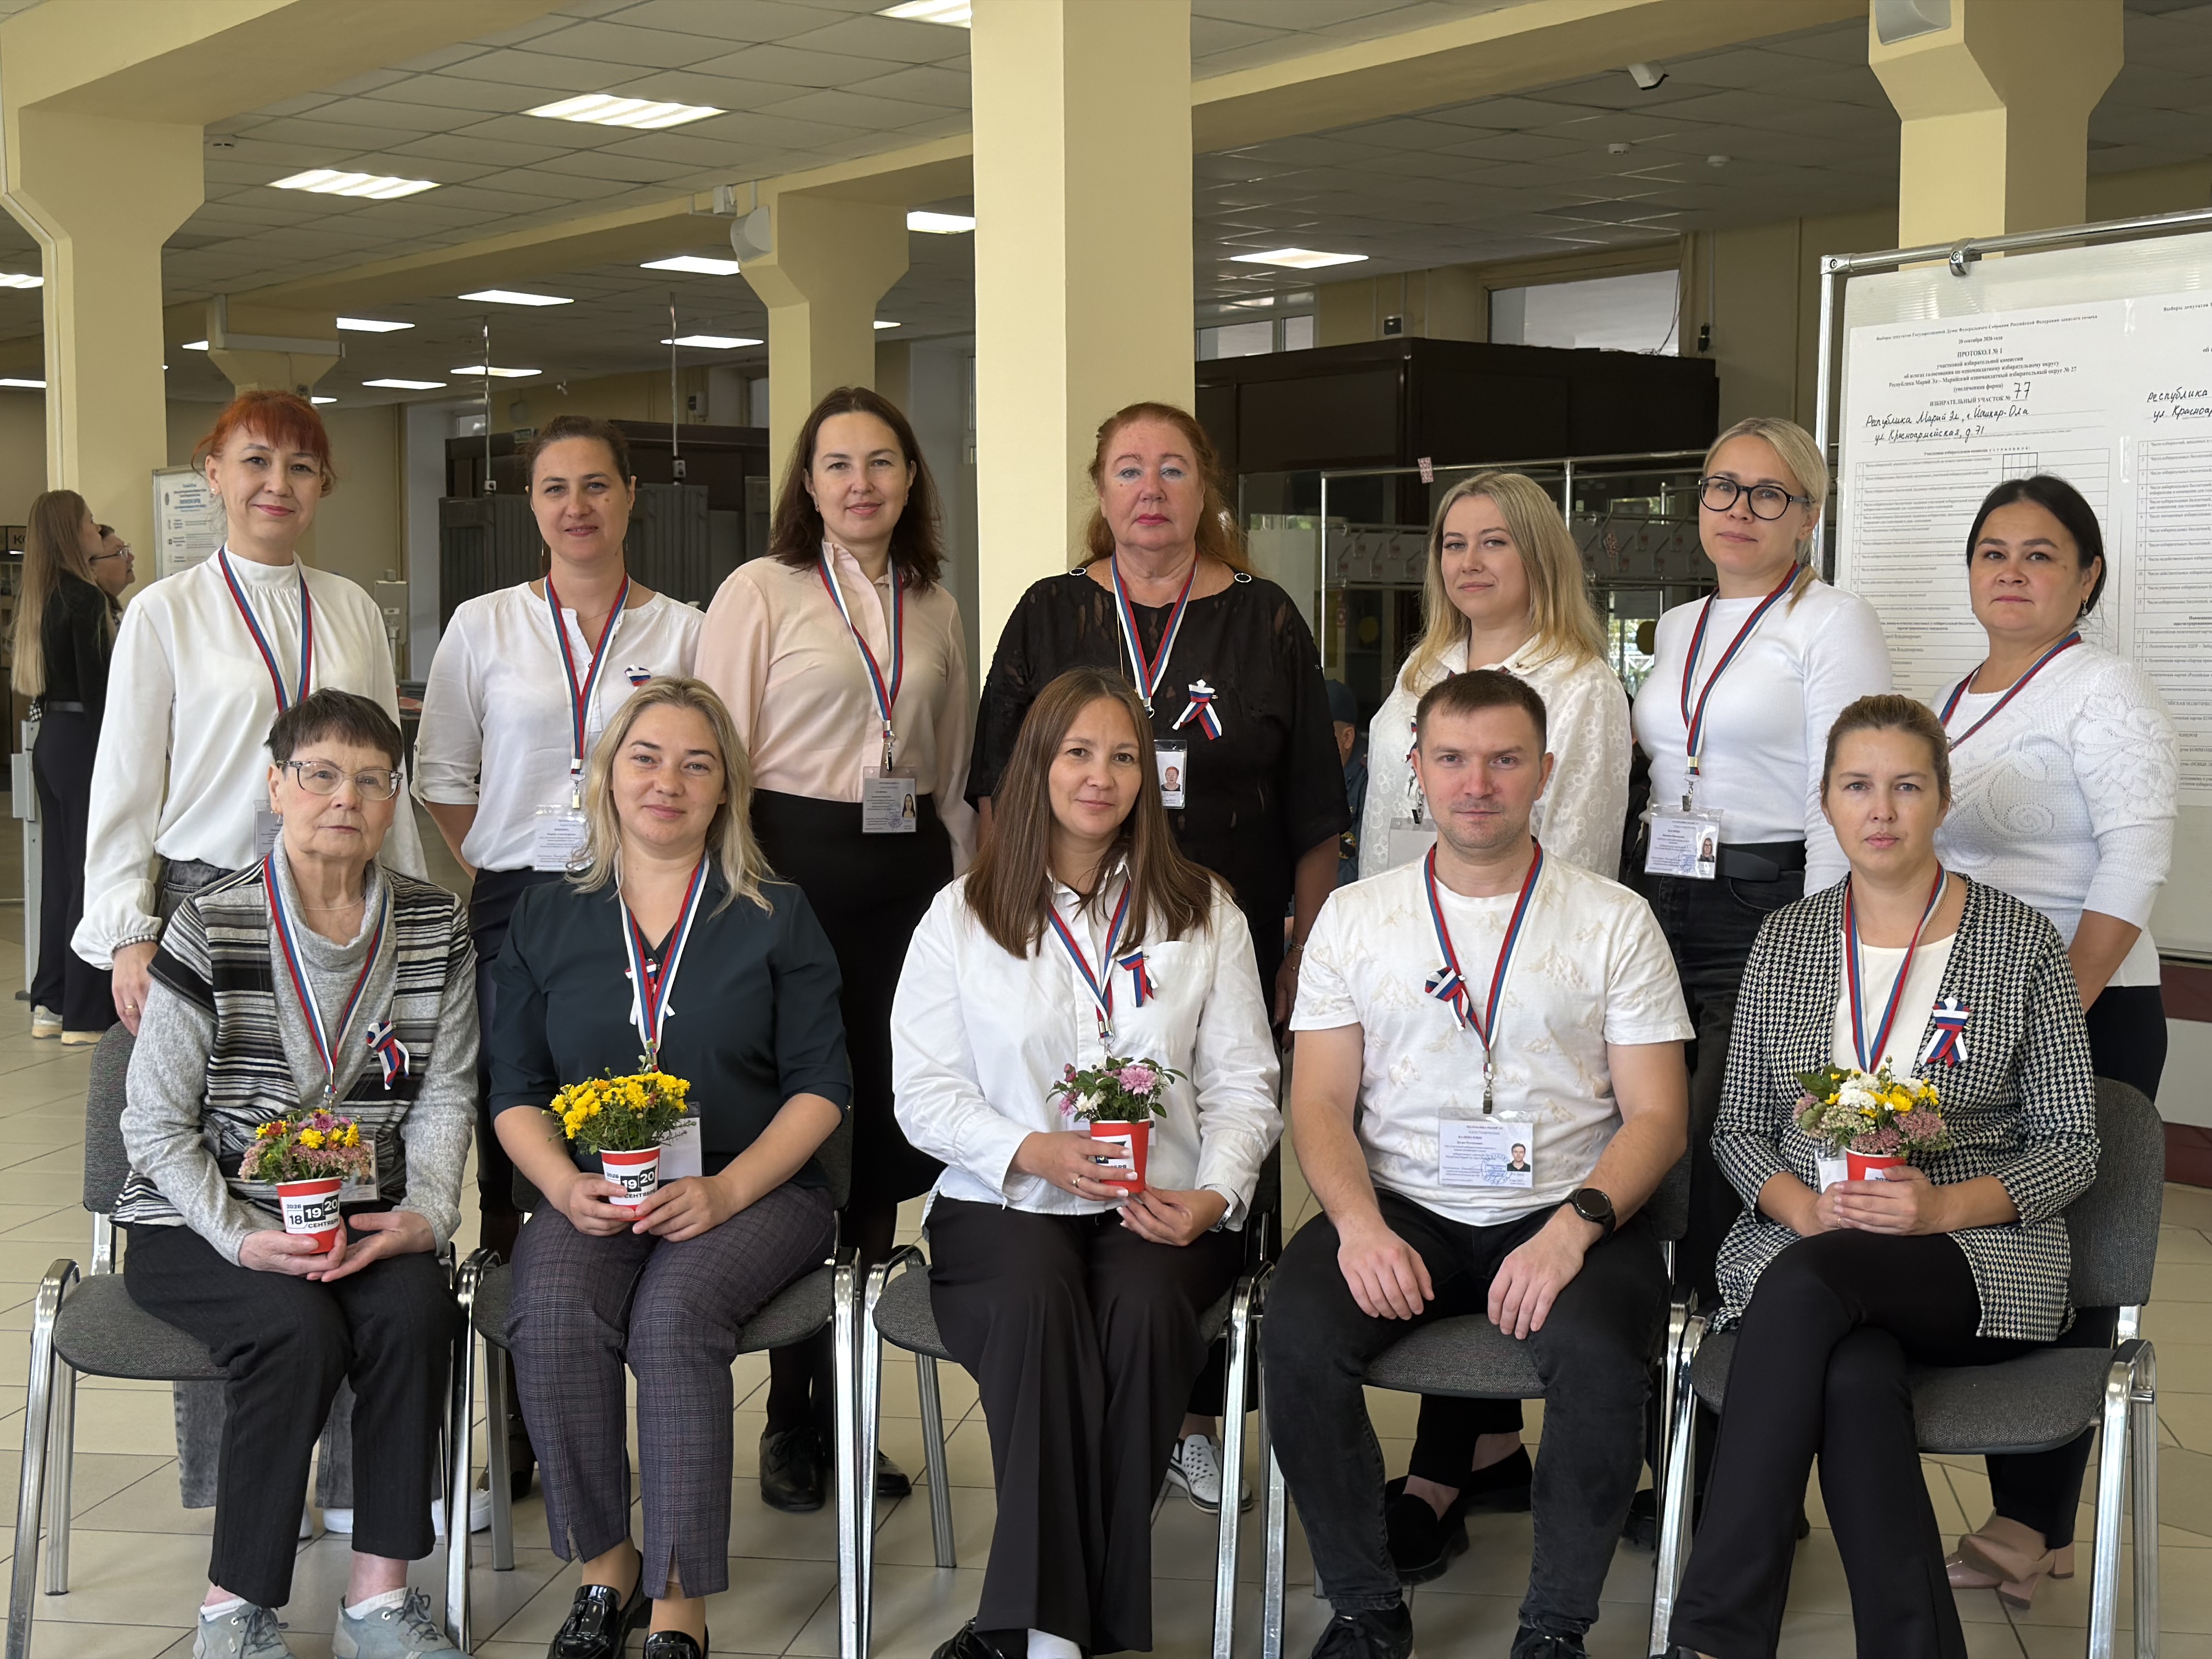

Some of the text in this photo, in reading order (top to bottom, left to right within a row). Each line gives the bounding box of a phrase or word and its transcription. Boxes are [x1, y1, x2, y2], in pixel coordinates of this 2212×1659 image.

[1957, 349, 1991, 358] ПРОТОКОЛ
[1929, 396, 1976, 407] ИЗБИРАТЕЛЬНЫЙ
[2014, 381, 2030, 399] 77
[1976, 425, 1984, 435] 71
[622, 1171, 655, 1189] 19 20
[289, 1199, 338, 1225] 18 19 20
